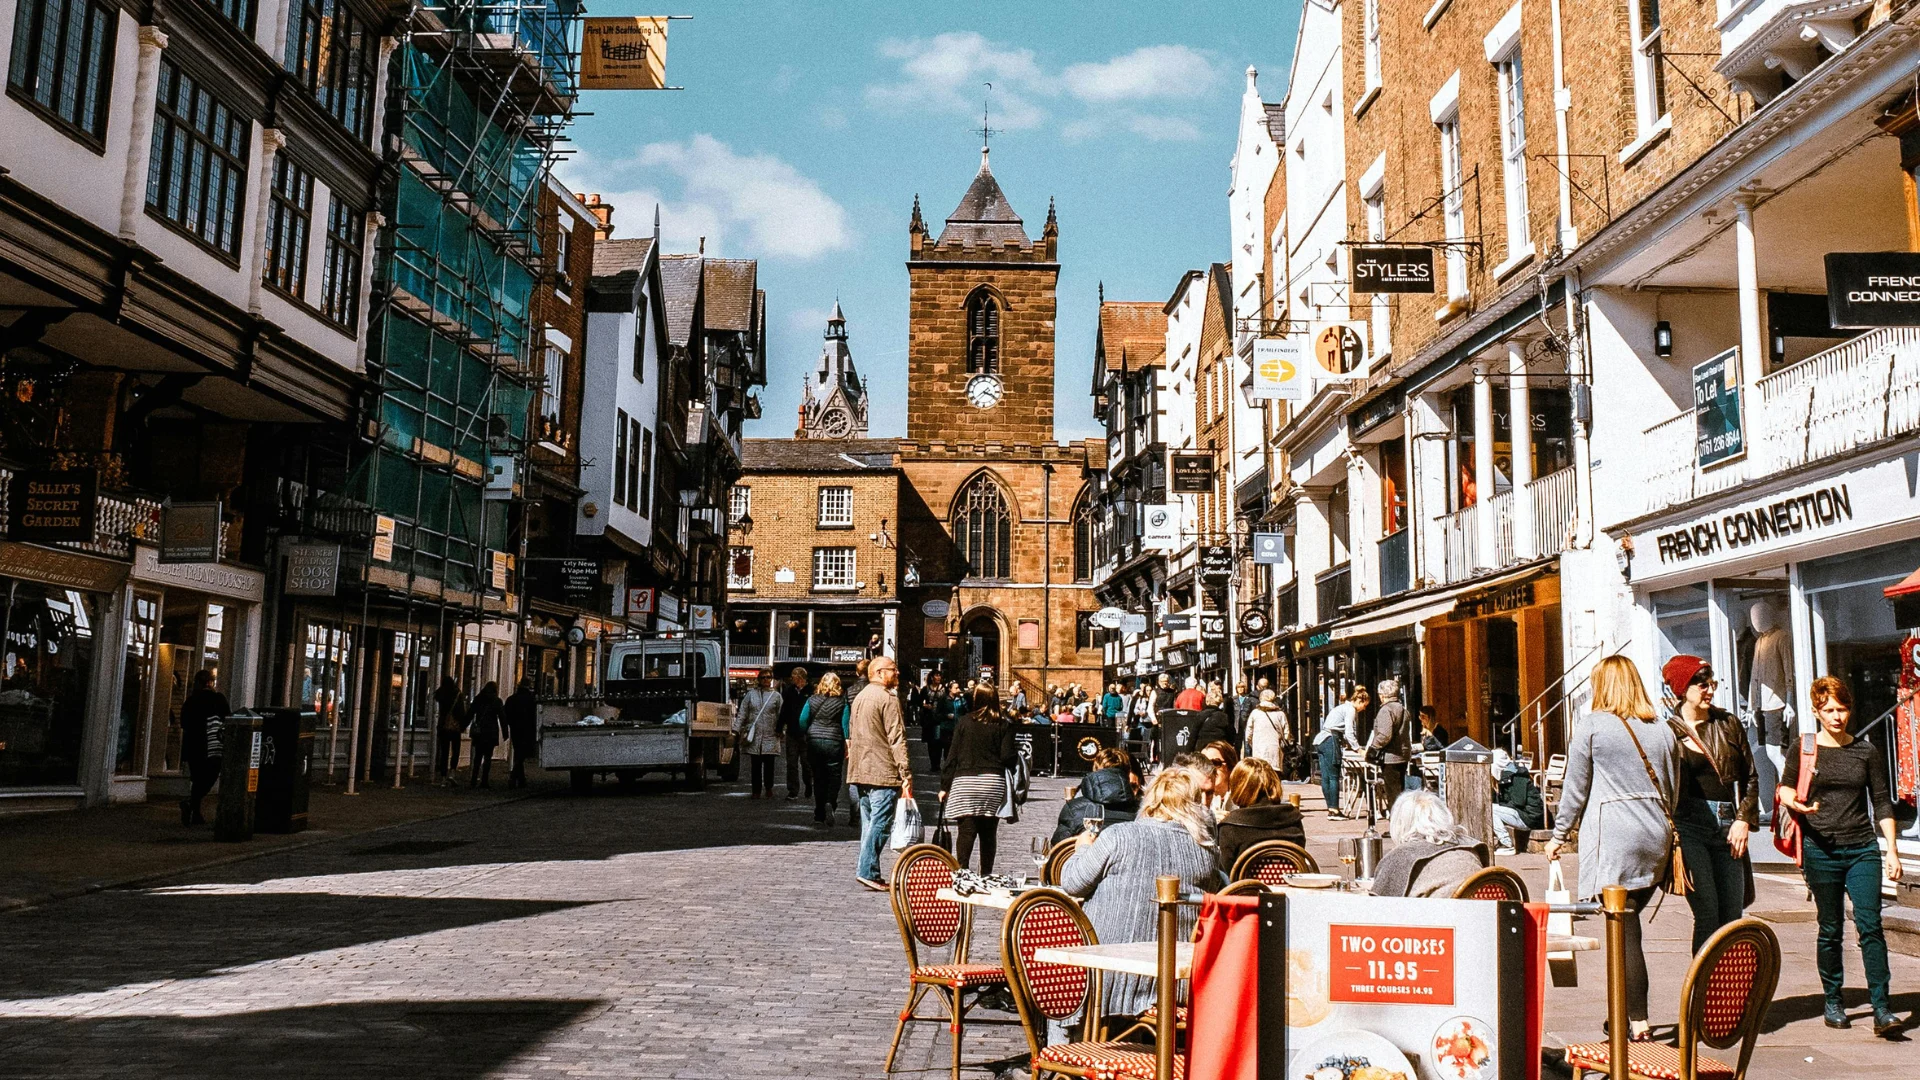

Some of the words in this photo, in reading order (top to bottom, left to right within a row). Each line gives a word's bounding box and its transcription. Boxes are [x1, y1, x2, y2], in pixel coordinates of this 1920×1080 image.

[586, 26, 601, 34] First
[602, 26, 614, 34] Lift
[615, 26, 652, 36] Scaffolding
[653, 26, 664, 34] Ltd
[1356, 264, 1429, 278] STYLERS
[1696, 385, 1704, 405] To
[1705, 380, 1717, 400] Let
[1700, 439, 1713, 458] 0161
[1713, 434, 1725, 452] 236
[28, 482, 81, 494] SALLY'S
[27, 498, 79, 511] SECRET
[22, 514, 81, 527] GARDEN
[1656, 520, 1722, 564] FRENCH
[1722, 484, 1852, 549] CONNECTION
[5, 566, 48, 578] ALTERNATIVE
[292, 566, 330, 577] COOK
[291, 578, 330, 589] SHOP
[1341, 936, 1376, 953] TWO
[1382, 938, 1445, 955] COURSES
[1368, 960, 1418, 980] 11.95
[1350, 985, 1374, 993] THREE
[1377, 986, 1410, 994] COURSES
[1413, 987, 1433, 995] 14.95
